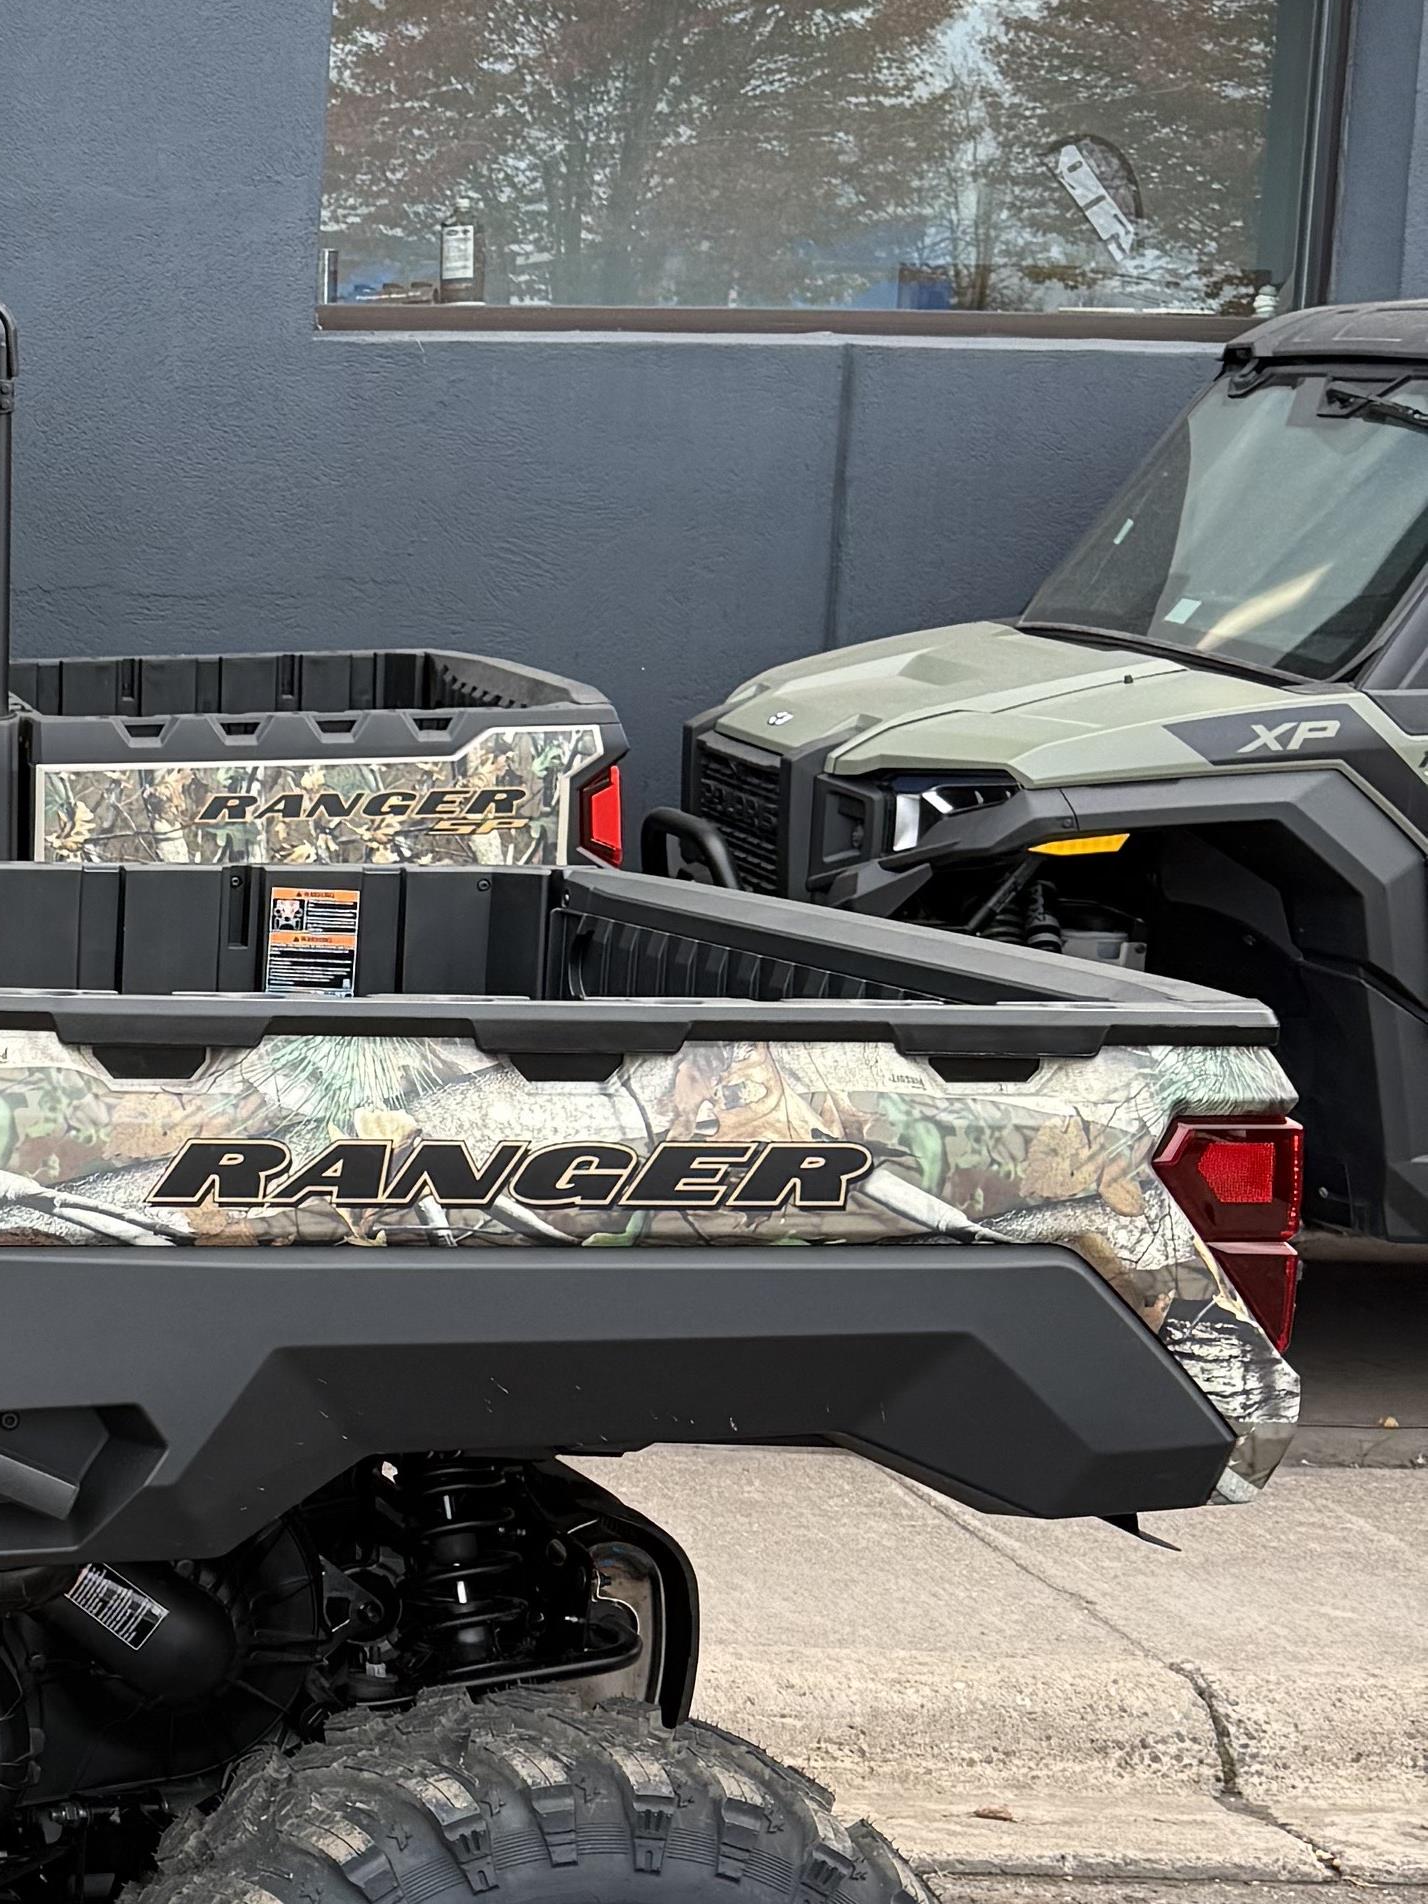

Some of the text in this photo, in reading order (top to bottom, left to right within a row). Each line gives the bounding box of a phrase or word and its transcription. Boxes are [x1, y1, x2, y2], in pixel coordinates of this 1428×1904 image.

[1236, 720, 1341, 753] XP
[194, 788, 528, 821] RANGER
[428, 818, 531, 836] SP
[144, 1138, 874, 1211] RANGER
